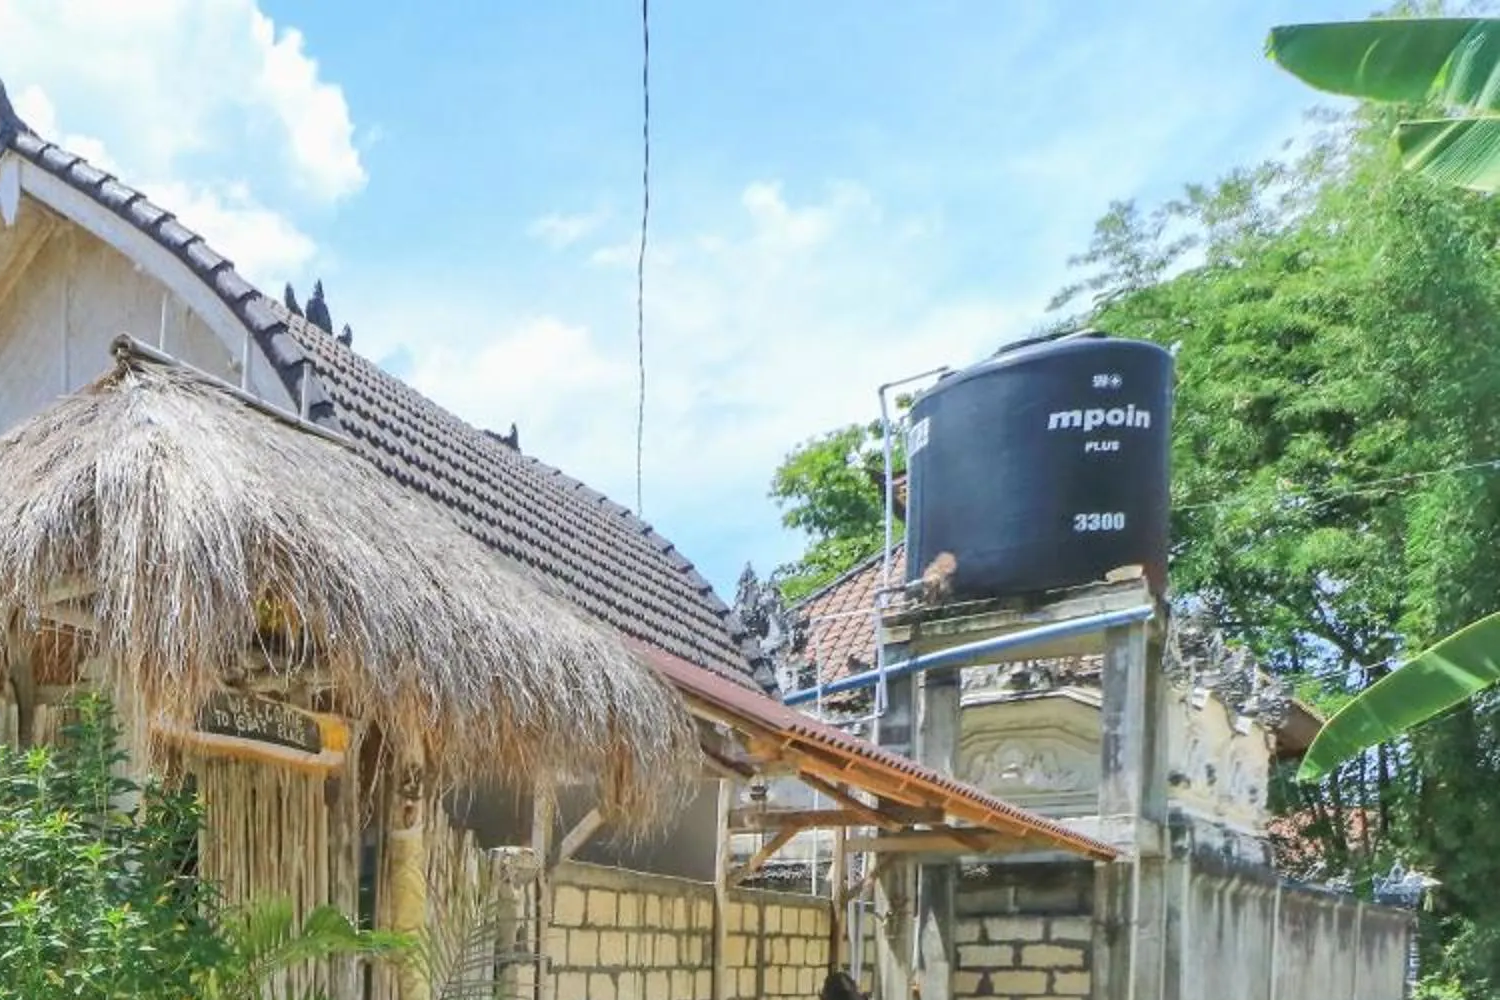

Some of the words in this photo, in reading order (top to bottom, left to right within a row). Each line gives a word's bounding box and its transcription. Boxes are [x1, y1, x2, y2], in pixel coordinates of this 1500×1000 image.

[1047, 404, 1151, 431] mpoin
[1084, 440, 1120, 452] PLUS
[1072, 512, 1125, 531] 3300
[215, 709, 229, 727] TO
